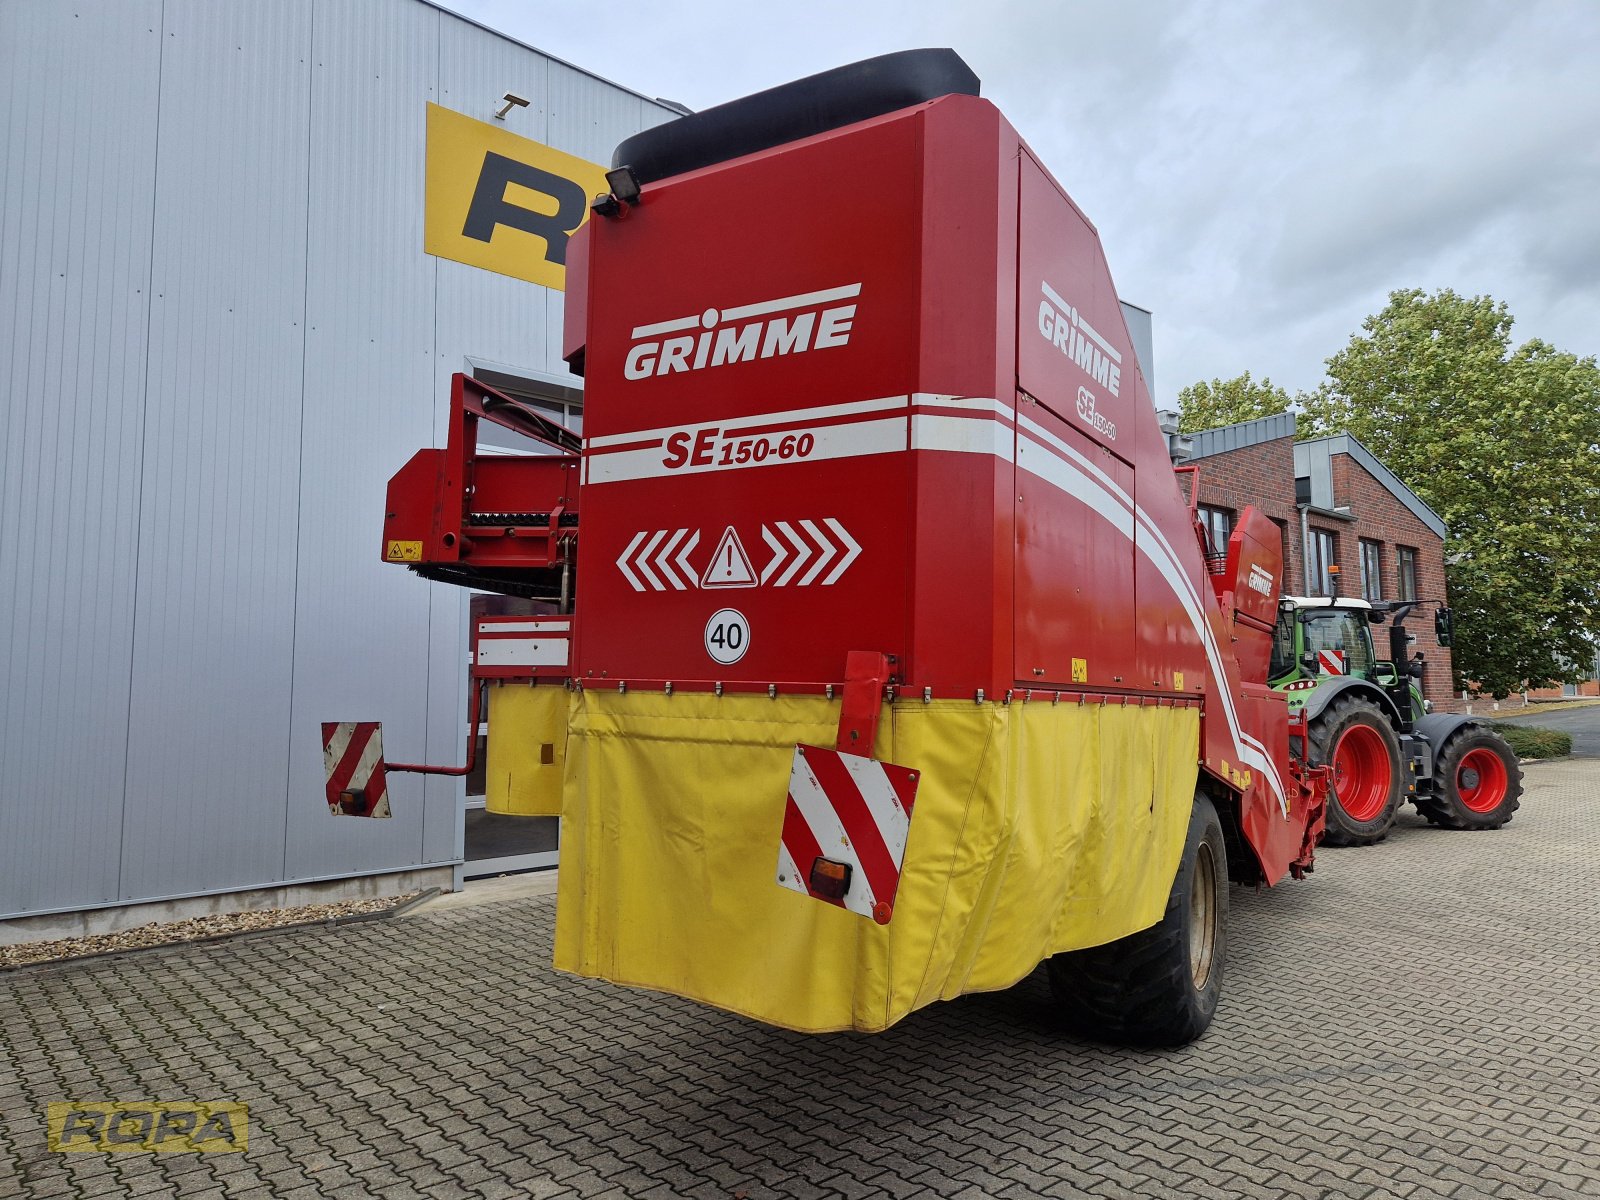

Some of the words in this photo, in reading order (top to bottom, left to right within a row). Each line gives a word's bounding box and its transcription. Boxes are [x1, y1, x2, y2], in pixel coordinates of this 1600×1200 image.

[462, 150, 586, 266] R
[624, 304, 857, 381] GRIMME
[1038, 300, 1121, 398] GRIMME
[1077, 386, 1096, 425] SE
[1094, 411, 1117, 441] 150-60
[662, 427, 720, 469] SE
[718, 433, 815, 466] 150-60
[1248, 571, 1273, 598] GRIMME
[710, 623, 742, 649] 40
